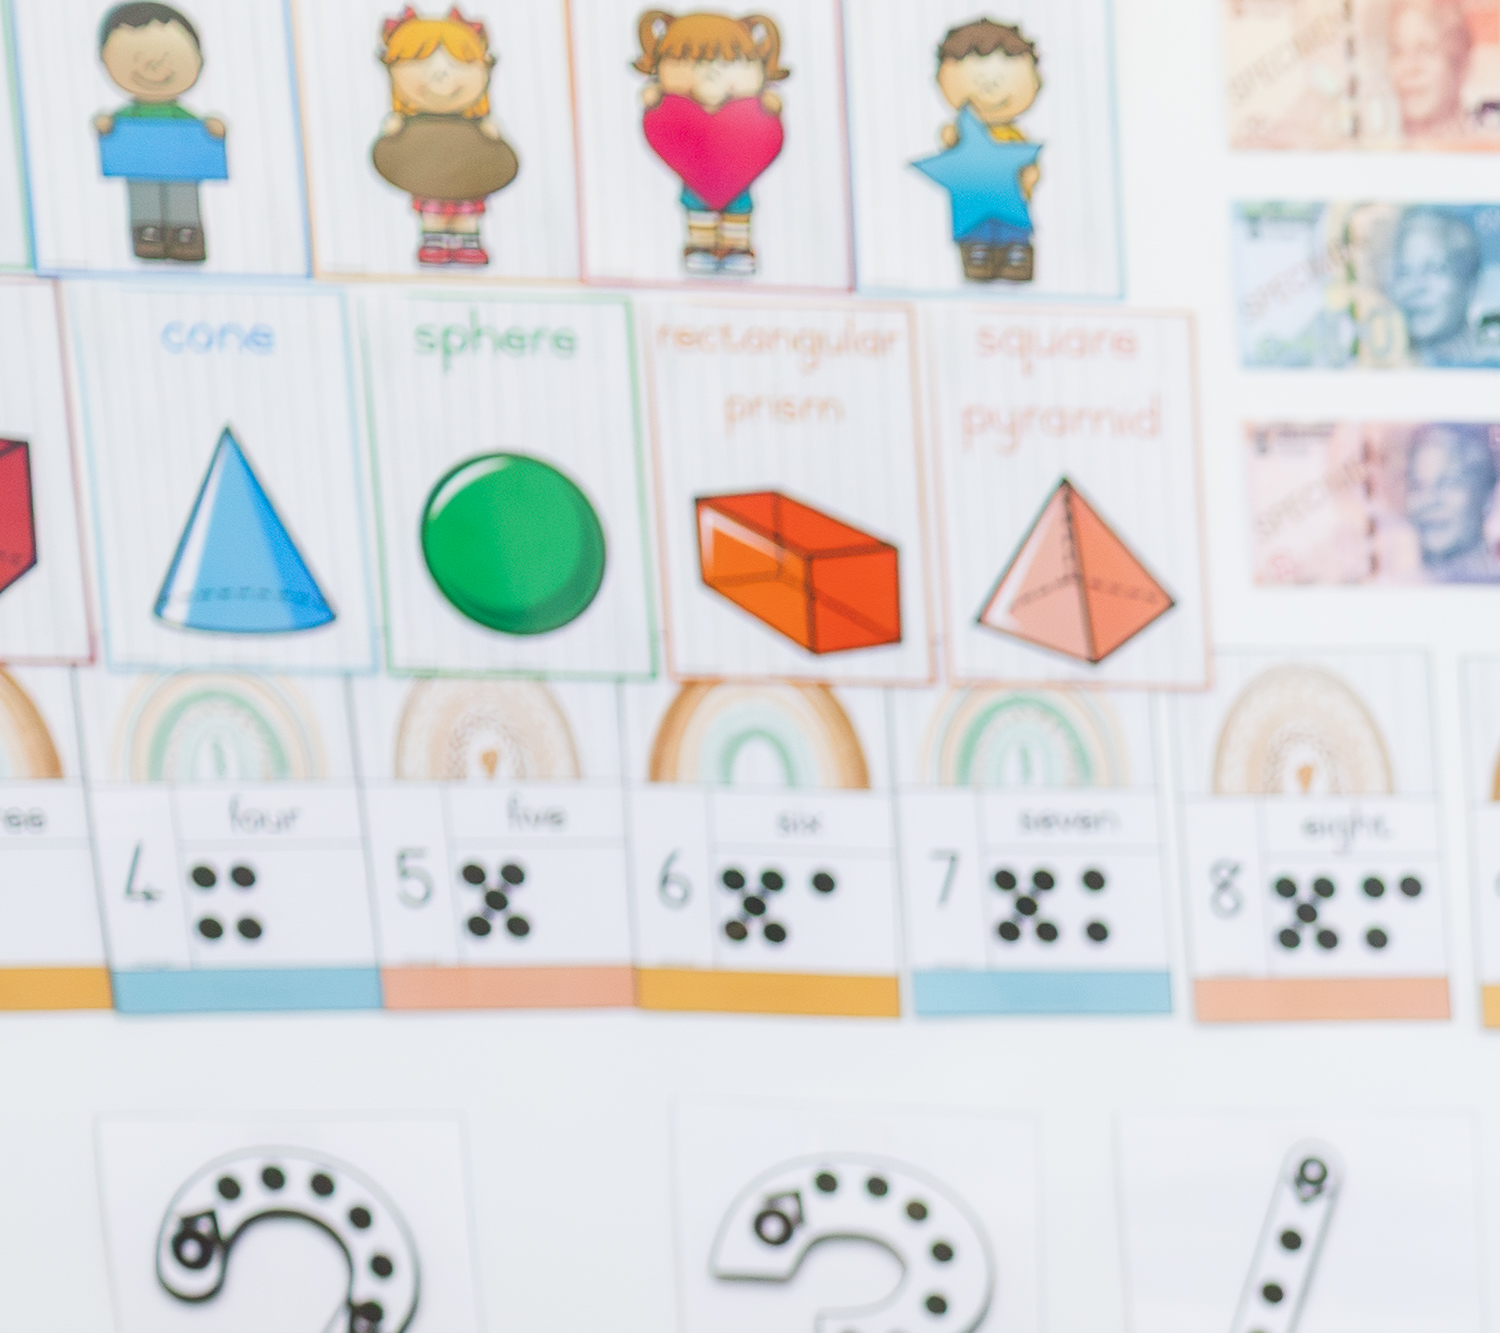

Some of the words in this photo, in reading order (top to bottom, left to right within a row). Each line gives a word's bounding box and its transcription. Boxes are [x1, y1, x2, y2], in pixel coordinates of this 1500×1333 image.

[160, 321, 276, 355] cone
[413, 315, 577, 362] sphere
[654, 319, 898, 364] rectangular
[974, 319, 1138, 366] square
[723, 390, 845, 432] prism
[959, 397, 1162, 444] pyramid
[228, 794, 299, 834] four
[506, 793, 567, 831] five
[1018, 811, 1118, 834] seven
[1299, 812, 1390, 855] eight
[123, 843, 160, 905] 4
[395, 847, 434, 909] 5
[657, 851, 693, 910] 6
[931, 849, 960, 907] 7
[1209, 860, 1244, 919] 8
